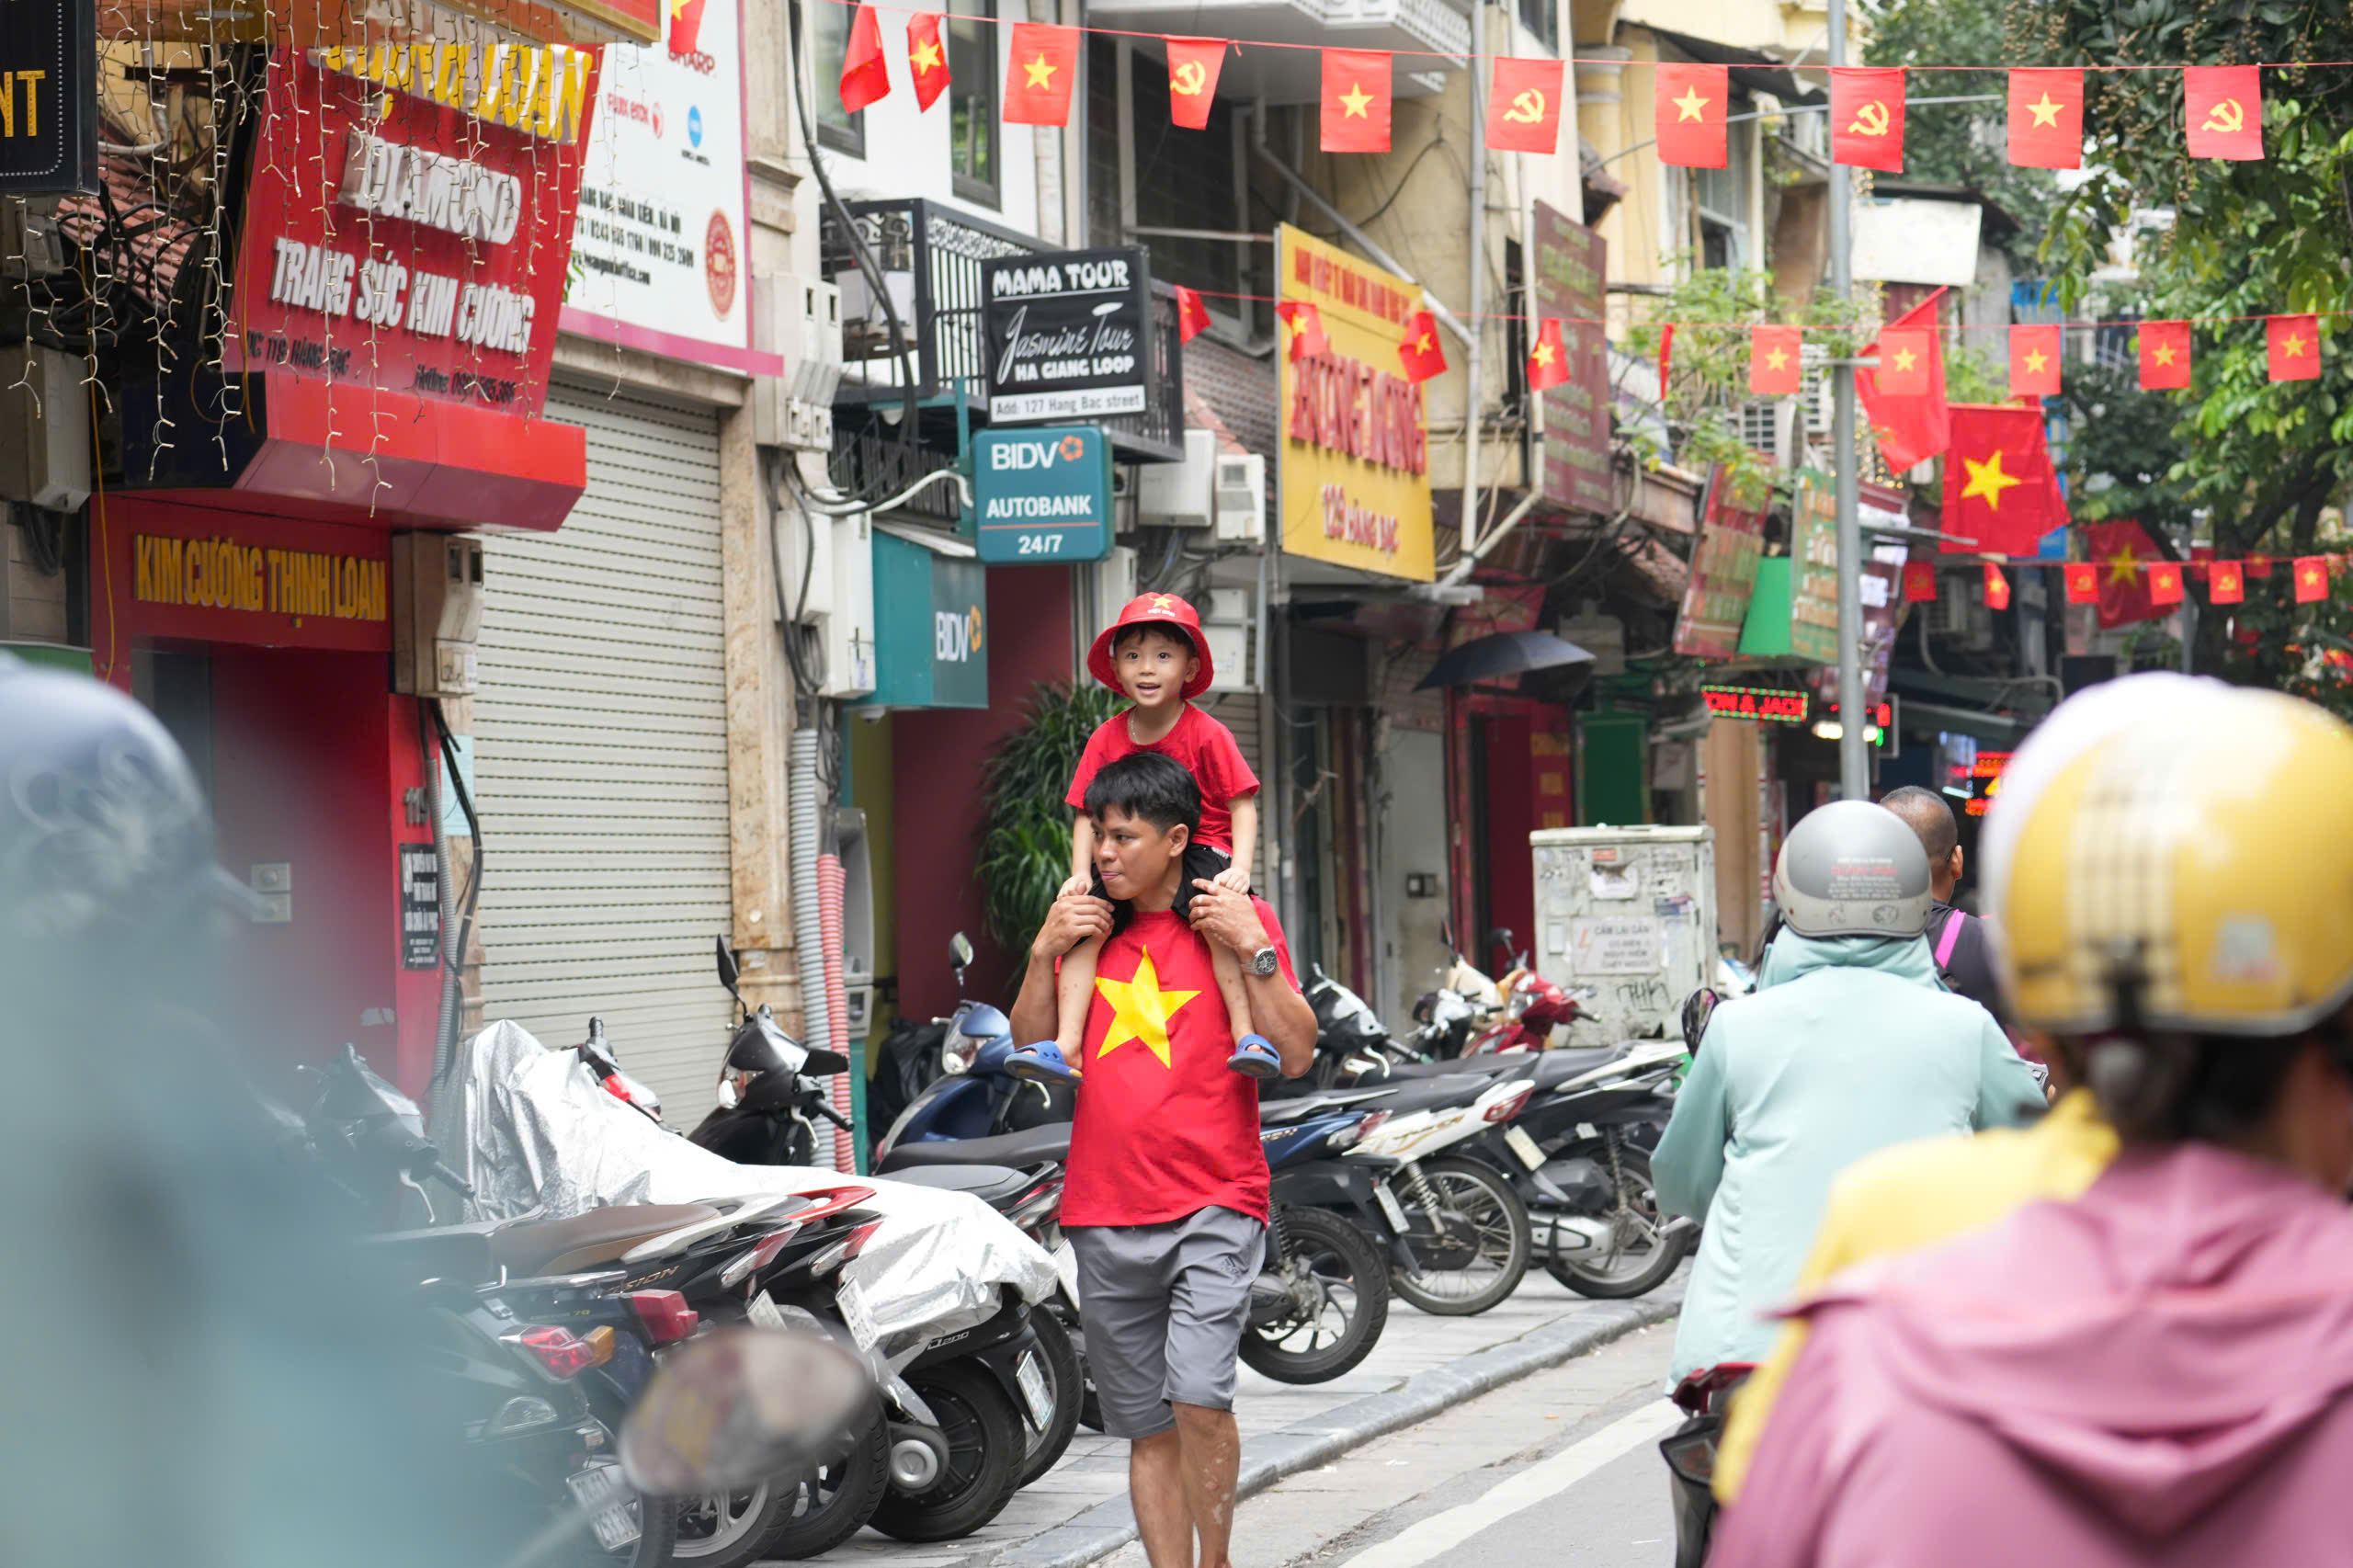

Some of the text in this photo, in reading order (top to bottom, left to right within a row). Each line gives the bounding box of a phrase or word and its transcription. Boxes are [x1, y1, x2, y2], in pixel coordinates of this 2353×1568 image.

[351, 134, 522, 245] DIAMOND
[271, 235, 536, 354] TRANG SỨC KIM CƯƠNG
[993, 259, 1130, 297] MAMA TOUR
[996, 304, 1088, 386] Jasmine
[1015, 355, 1135, 382] HA GIANG LOOP
[1025, 398, 1045, 414] 127
[1049, 396, 1077, 413] Hang
[1081, 395, 1102, 410] Bac
[1106, 393, 1141, 407] street
[991, 440, 1060, 471] BIDV
[986, 494, 1093, 519] AUTOBANK
[1017, 534, 1063, 555] 24/7
[135, 534, 387, 629] KIM CƯƠNG THỊNH LOAN
[935, 610, 971, 662] BIDV
